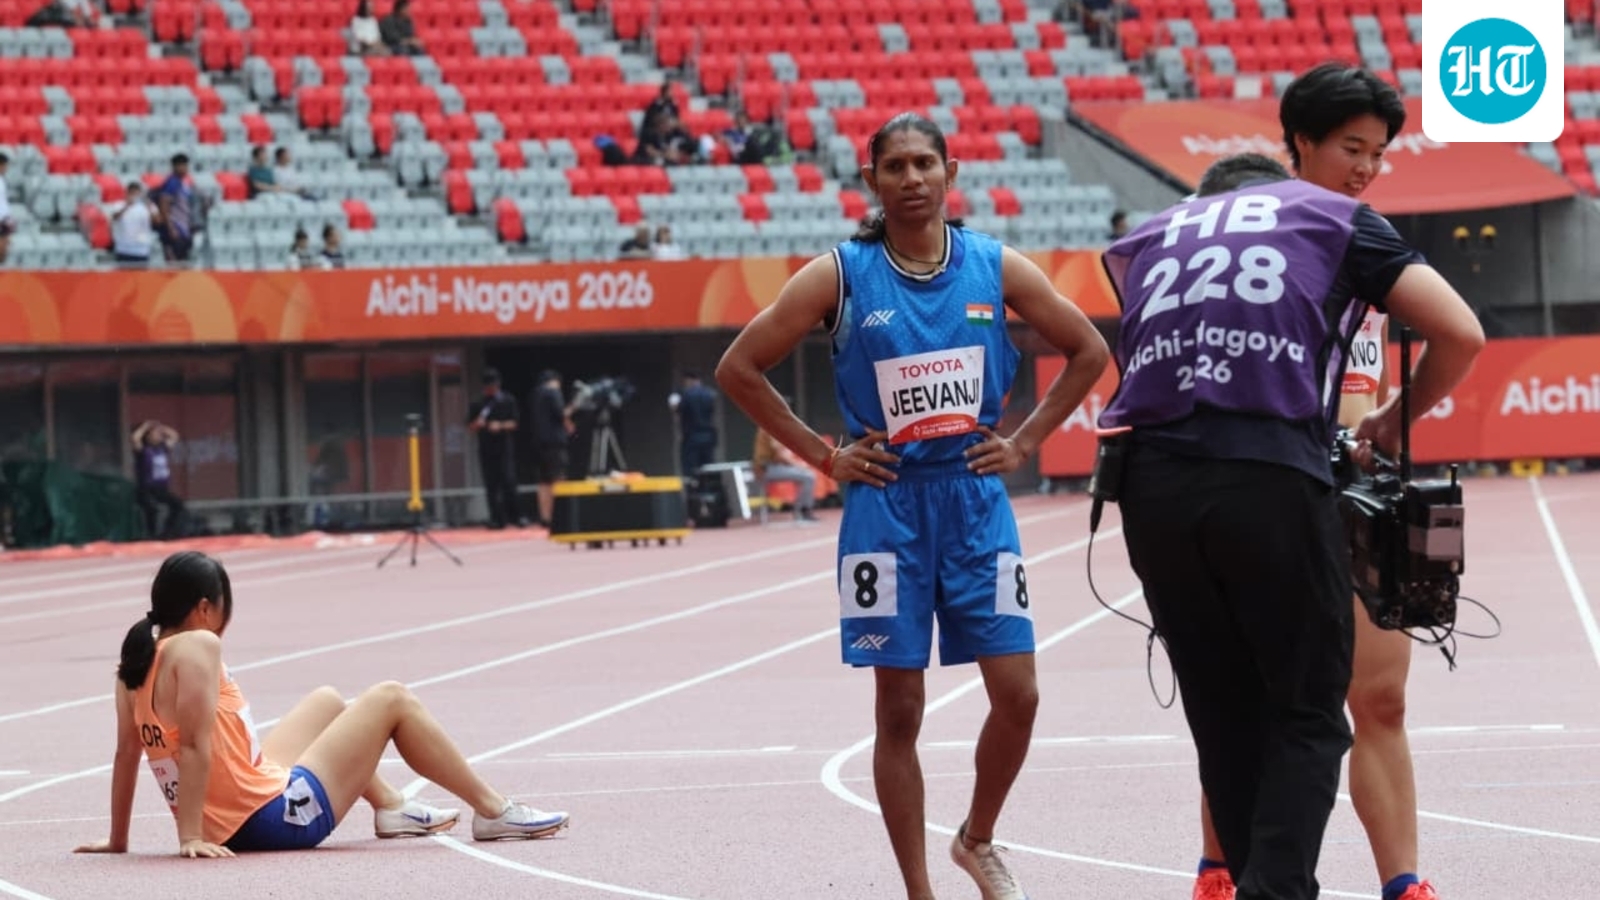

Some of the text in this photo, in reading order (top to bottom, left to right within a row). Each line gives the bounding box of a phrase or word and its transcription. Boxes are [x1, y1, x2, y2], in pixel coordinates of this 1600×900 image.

[1162, 194, 1281, 248] HB
[366, 270, 653, 323] Aichi-Nagoya 2026
[1141, 245, 1287, 323] 228
[899, 359, 964, 379] TOYOTA
[889, 377, 979, 417] JEEVANJI
[853, 560, 878, 609] 8
[1015, 563, 1029, 609] 8
[142, 723, 166, 749] OR
